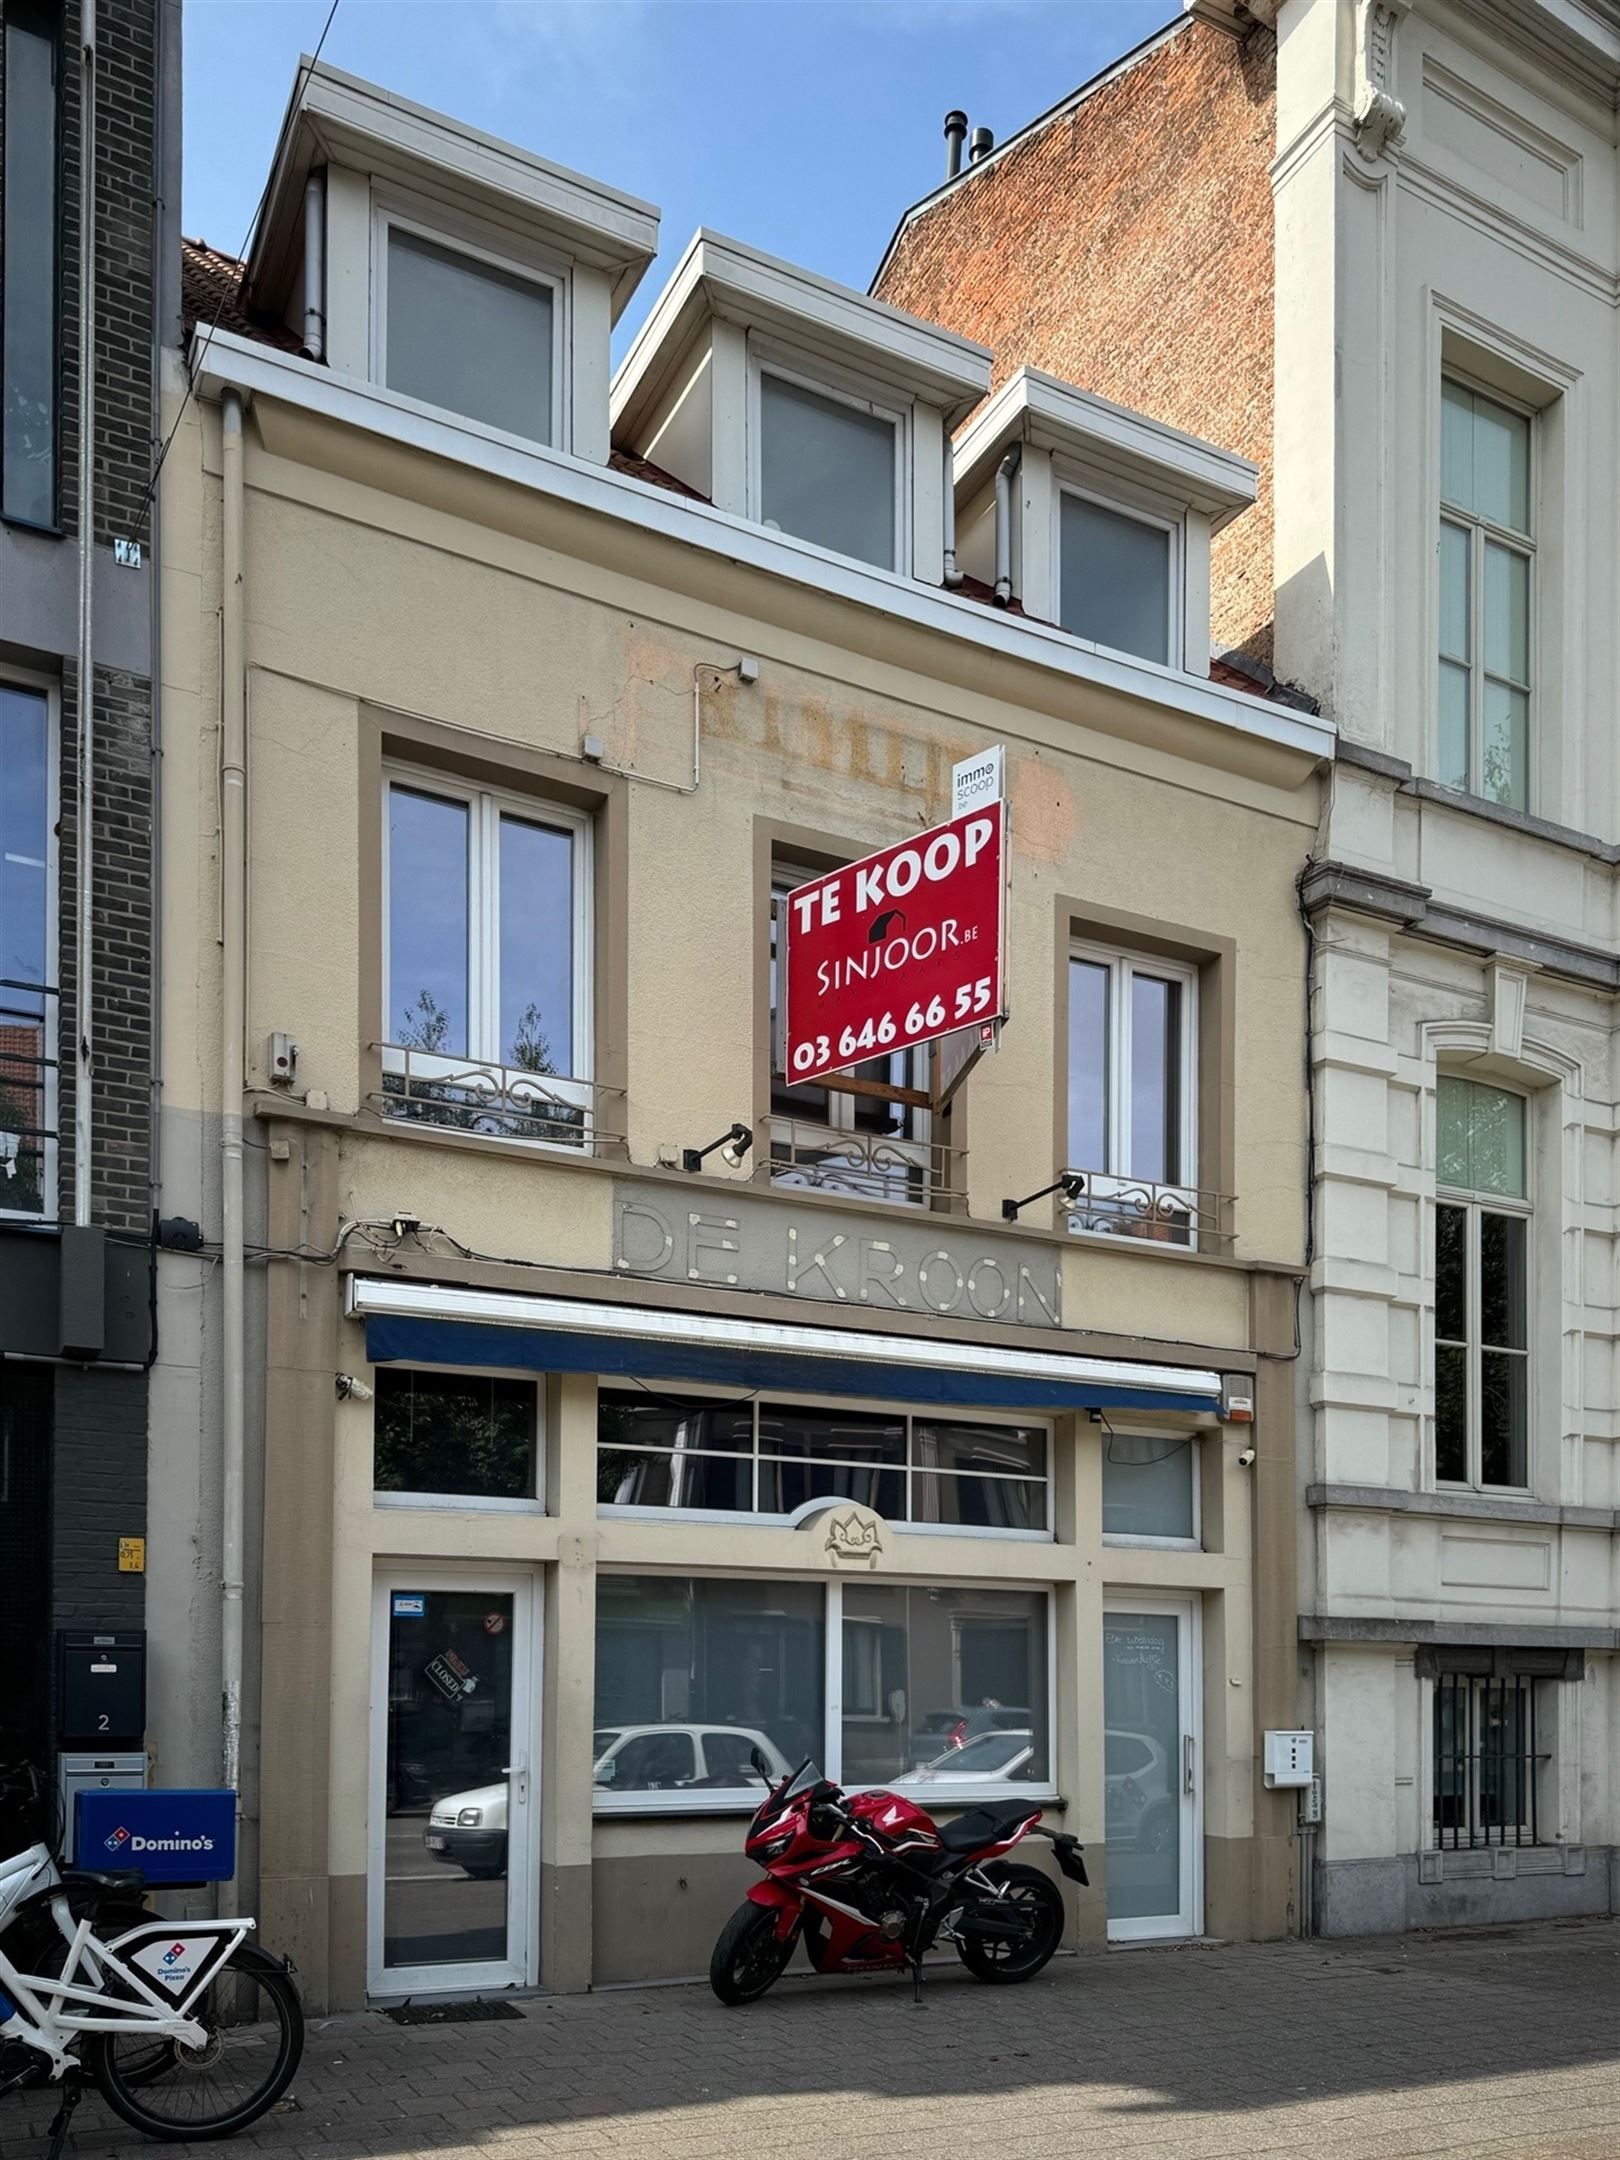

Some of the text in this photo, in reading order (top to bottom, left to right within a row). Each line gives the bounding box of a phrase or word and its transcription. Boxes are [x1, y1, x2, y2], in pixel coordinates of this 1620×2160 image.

[957, 763, 994, 787] immo
[957, 776, 994, 800] scoop
[793, 819, 993, 935] TE KOOP
[793, 976, 992, 1071] 03 646 66 55
[613, 1200, 1062, 1327] DE KROON
[431, 1661, 459, 1692] CLOSED
[98, 1714, 110, 1730] 2
[131, 1830, 214, 1851] Domino's
[157, 1966, 191, 1975] Domino's
